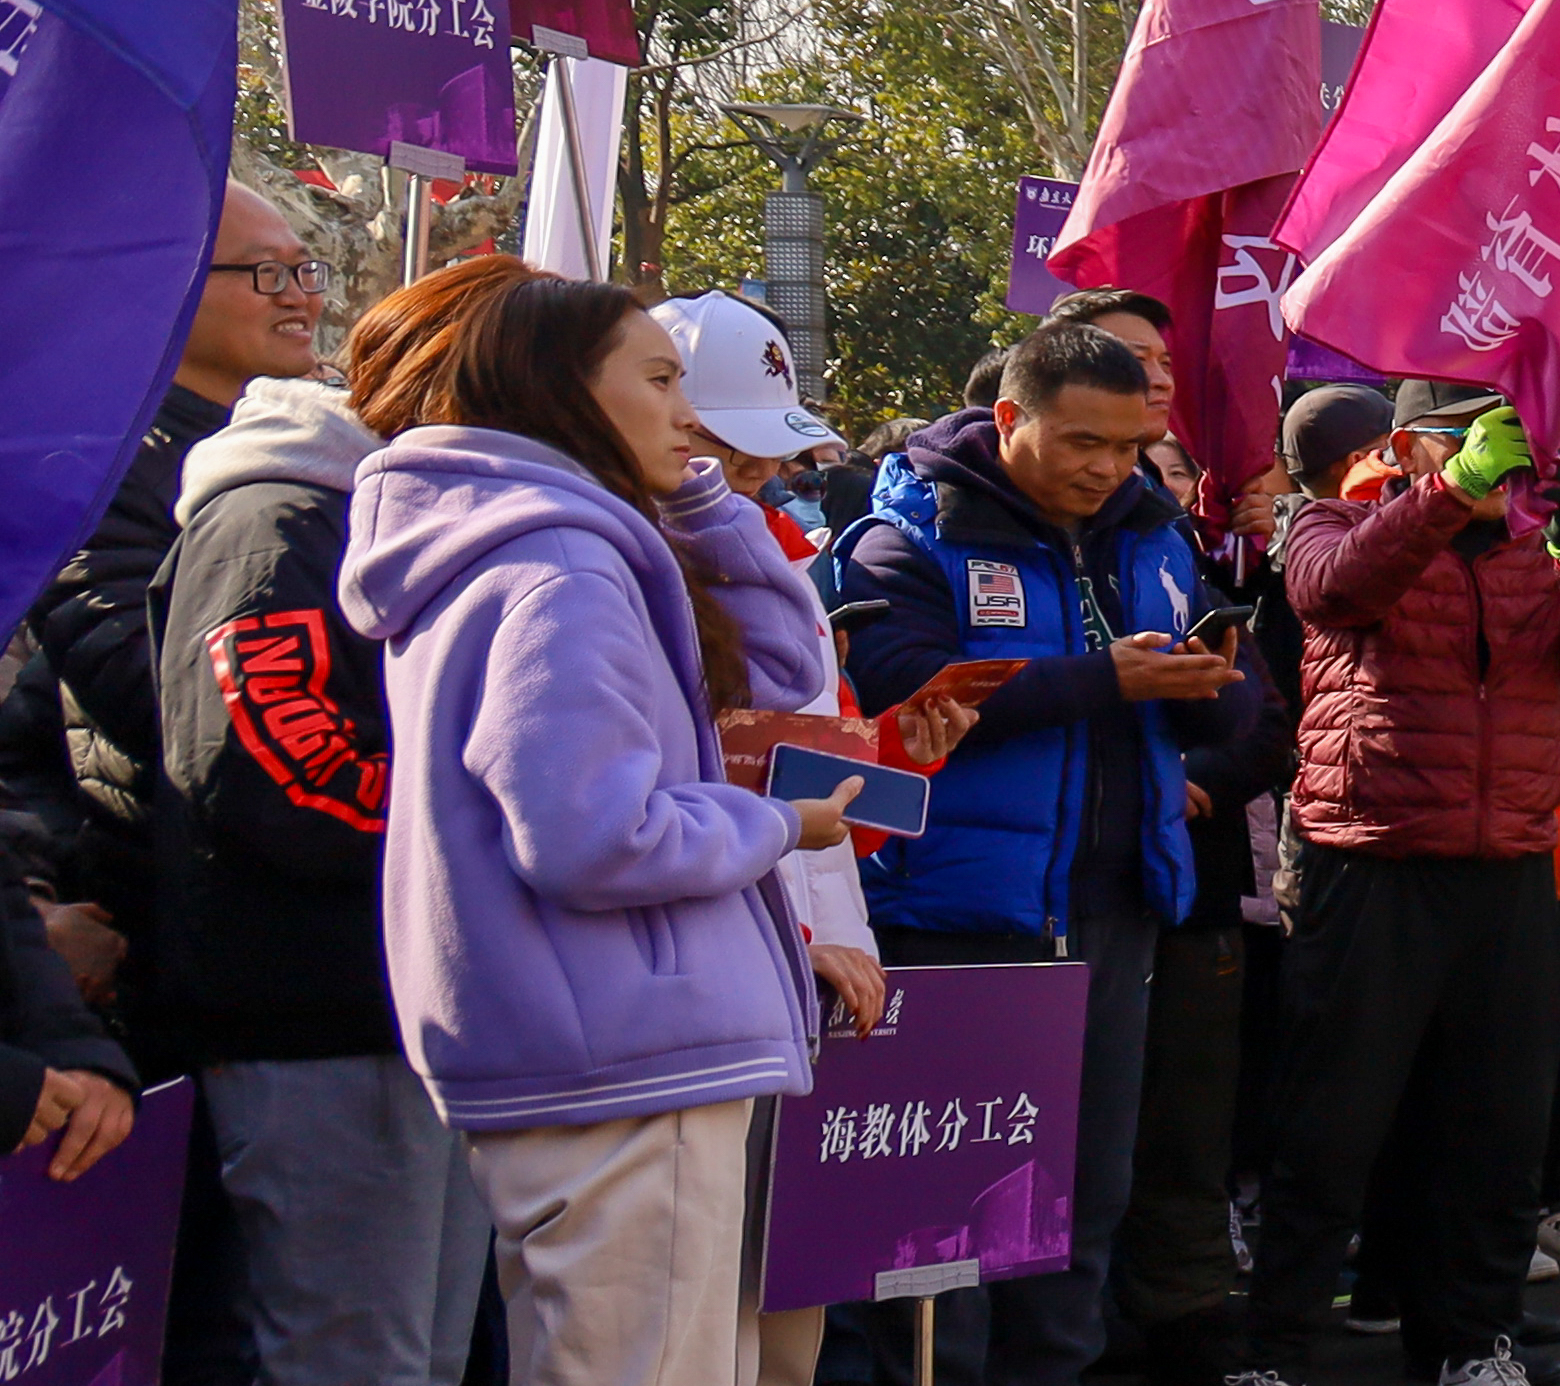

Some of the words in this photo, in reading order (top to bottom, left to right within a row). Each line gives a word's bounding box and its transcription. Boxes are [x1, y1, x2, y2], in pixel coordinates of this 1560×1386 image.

[974, 595, 1021, 608] USA
[819, 1092, 1040, 1164] 海教体分工会
